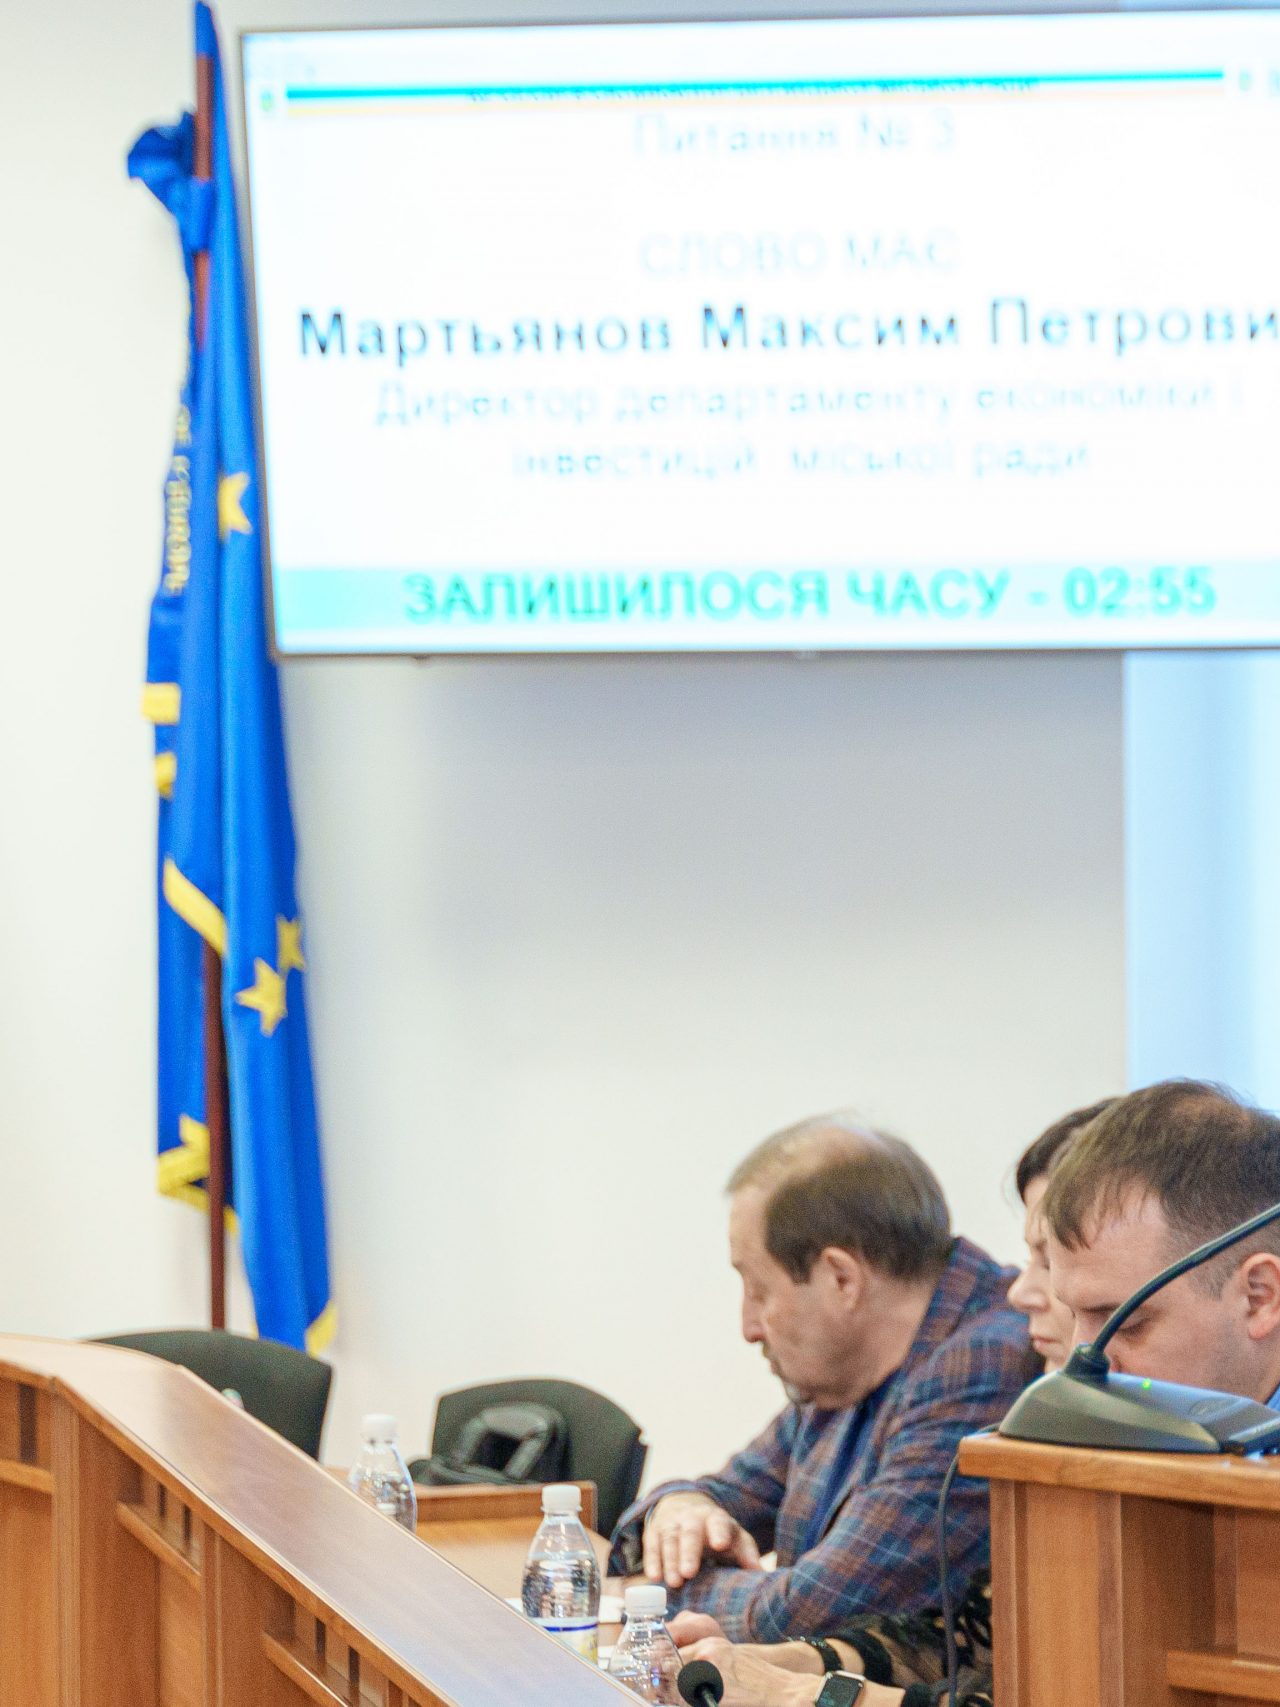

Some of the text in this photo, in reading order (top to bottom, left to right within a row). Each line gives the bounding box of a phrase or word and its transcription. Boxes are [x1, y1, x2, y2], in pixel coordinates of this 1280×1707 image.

[639, 229, 831, 281] СЛОВО
[300, 308, 672, 367] Мартьянов
[701, 304, 961, 351] Максим
[373, 379, 600, 427] Директор
[612, 383, 952, 426] департаменту
[975, 381, 1215, 413] економіки
[789, 440, 954, 476] міської
[972, 442, 1088, 478] ради
[404, 571, 829, 623] ЗАЛИШИЛОСЯ
[847, 567, 1010, 619] ЧАСУ
[1063, 566, 1216, 618] 02:55
